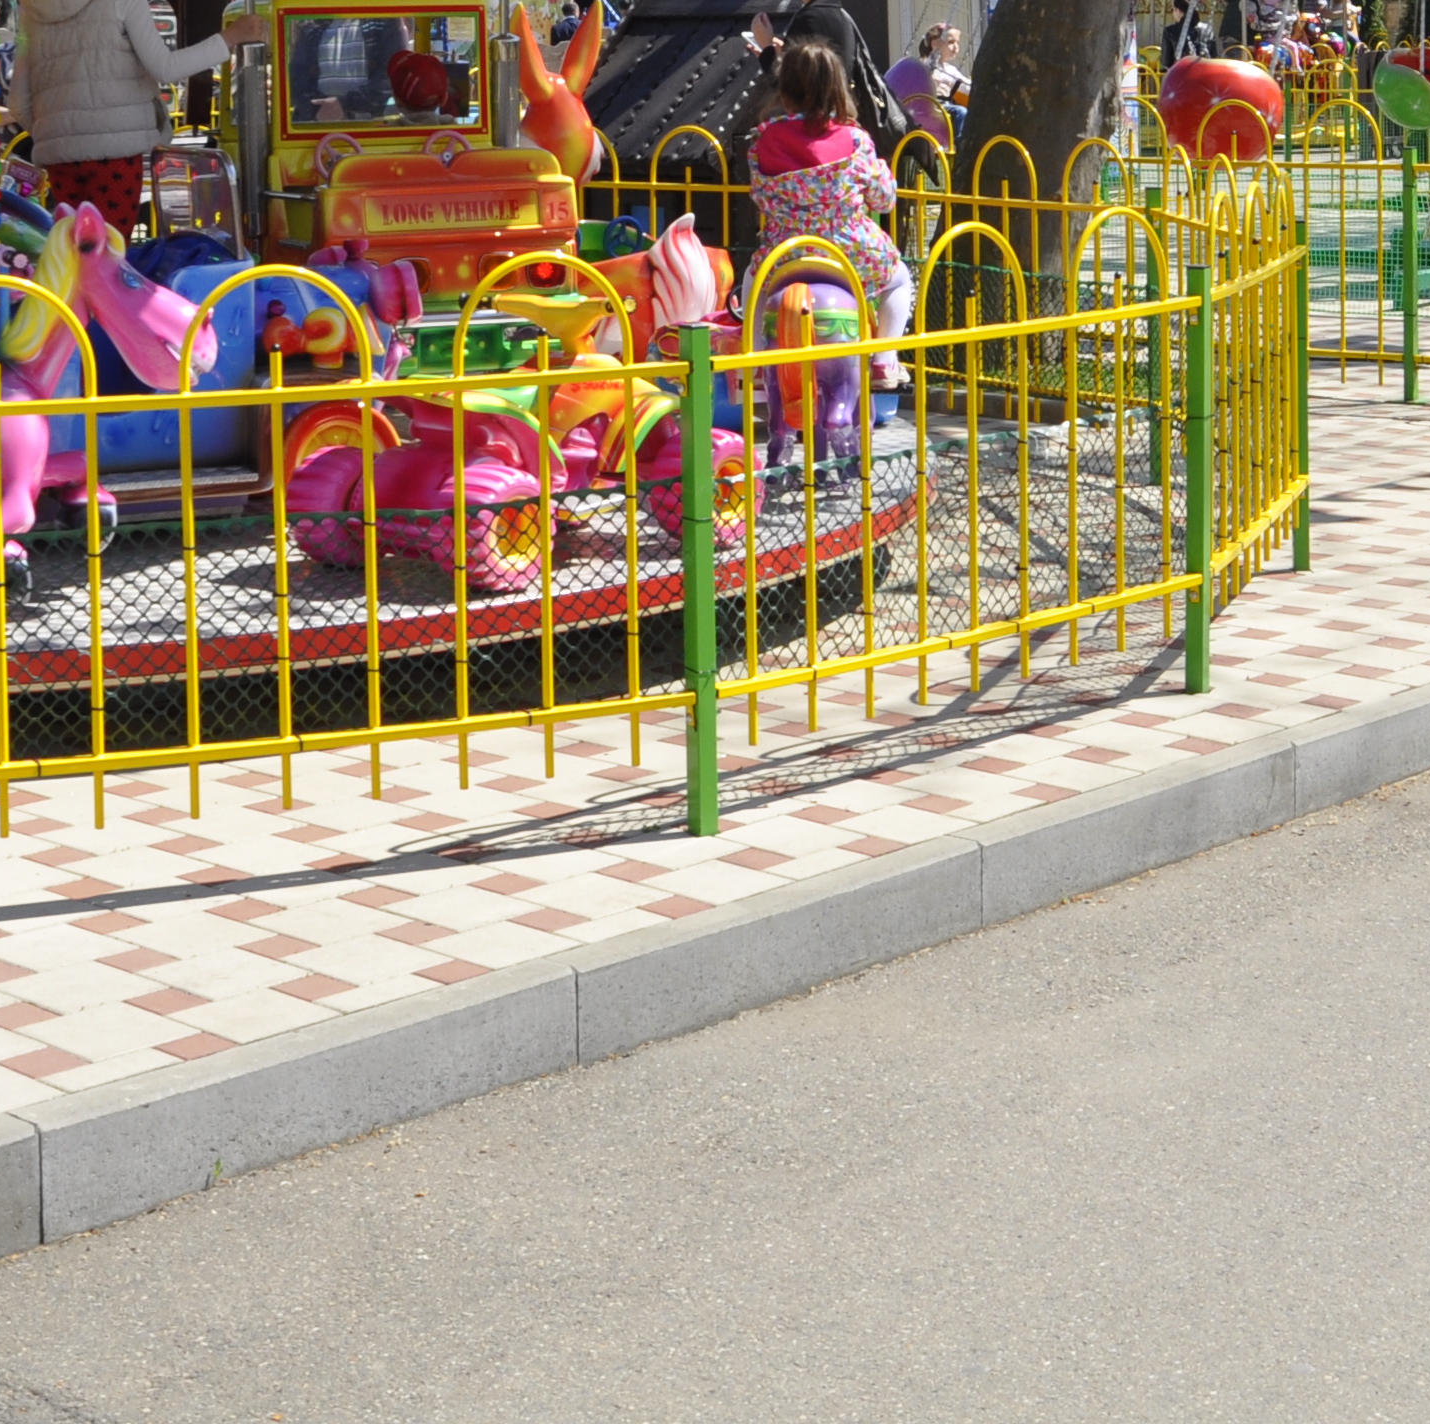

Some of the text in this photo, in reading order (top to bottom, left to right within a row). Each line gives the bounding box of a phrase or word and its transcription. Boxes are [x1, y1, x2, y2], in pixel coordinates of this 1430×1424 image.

[381, 198, 521, 226] LONG VEHICLE
[547, 200, 570, 221] 15
